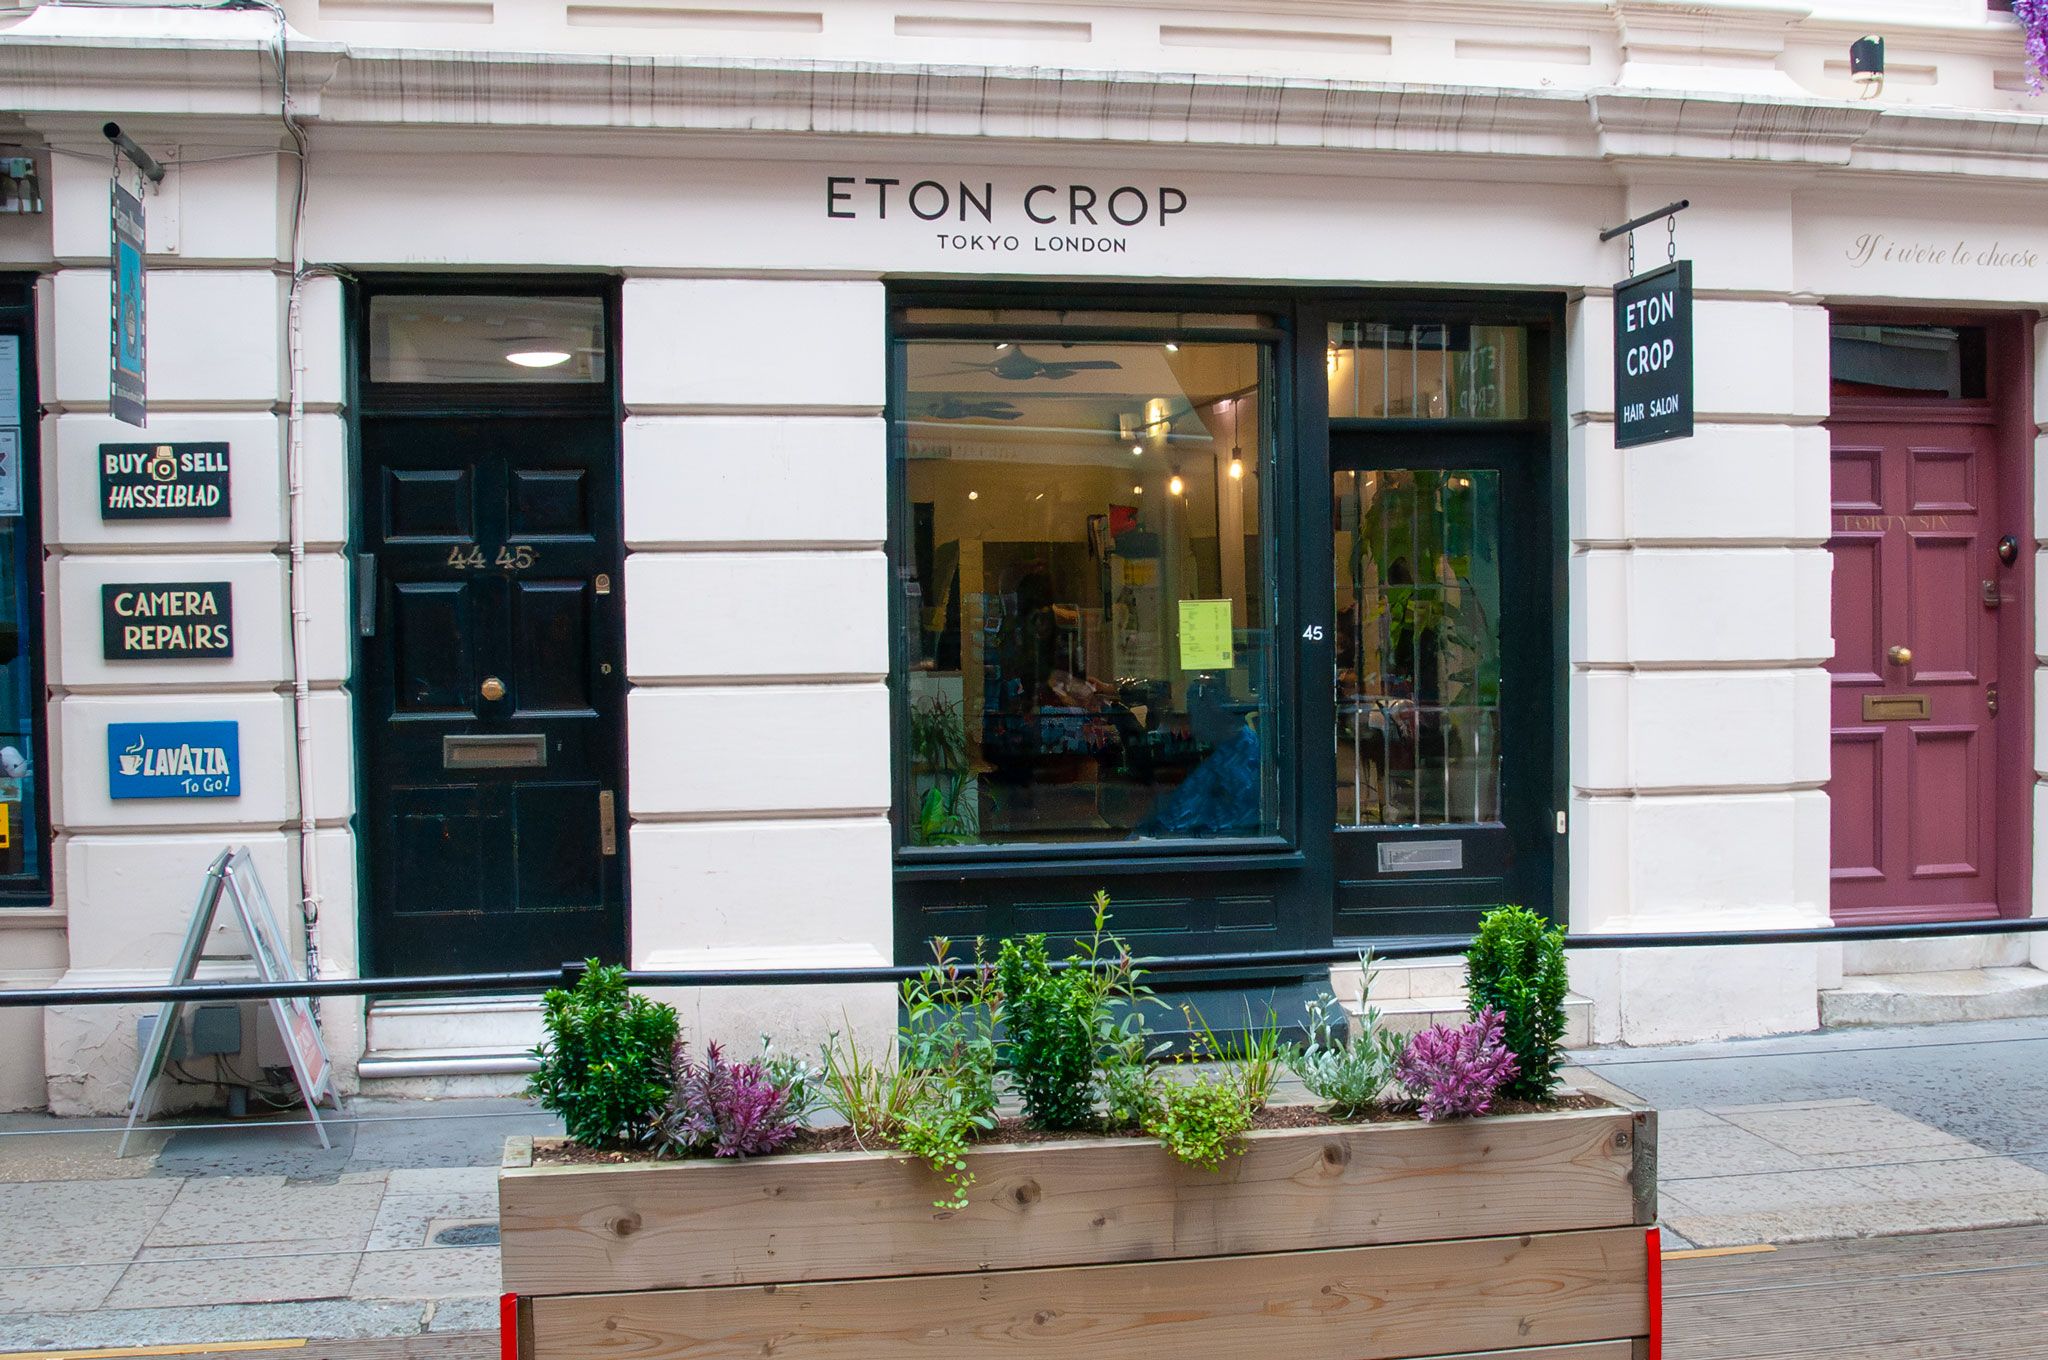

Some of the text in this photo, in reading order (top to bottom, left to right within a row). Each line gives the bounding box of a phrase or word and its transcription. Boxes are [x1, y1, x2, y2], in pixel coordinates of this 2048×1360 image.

[827, 176, 1188, 227] ETON CROP
[937, 234, 1126, 253] TOKYO LONDON
[1976, 241, 2039, 268] choose
[1626, 291, 1675, 333] ETON
[1626, 338, 1675, 377] CROP
[1623, 394, 1679, 424] HAIR SALON
[105, 452, 228, 475] BUY SELL
[108, 484, 220, 509] HASSELBLAD
[1843, 515, 1908, 531] FORTY
[447, 545, 533, 569] 44 45
[113, 590, 219, 617] CAMERA
[124, 623, 230, 650] REPAIRS
[1302, 624, 1323, 640] 45
[143, 743, 230, 777] LAVAZZA
[181, 775, 230, 794] To Go!
